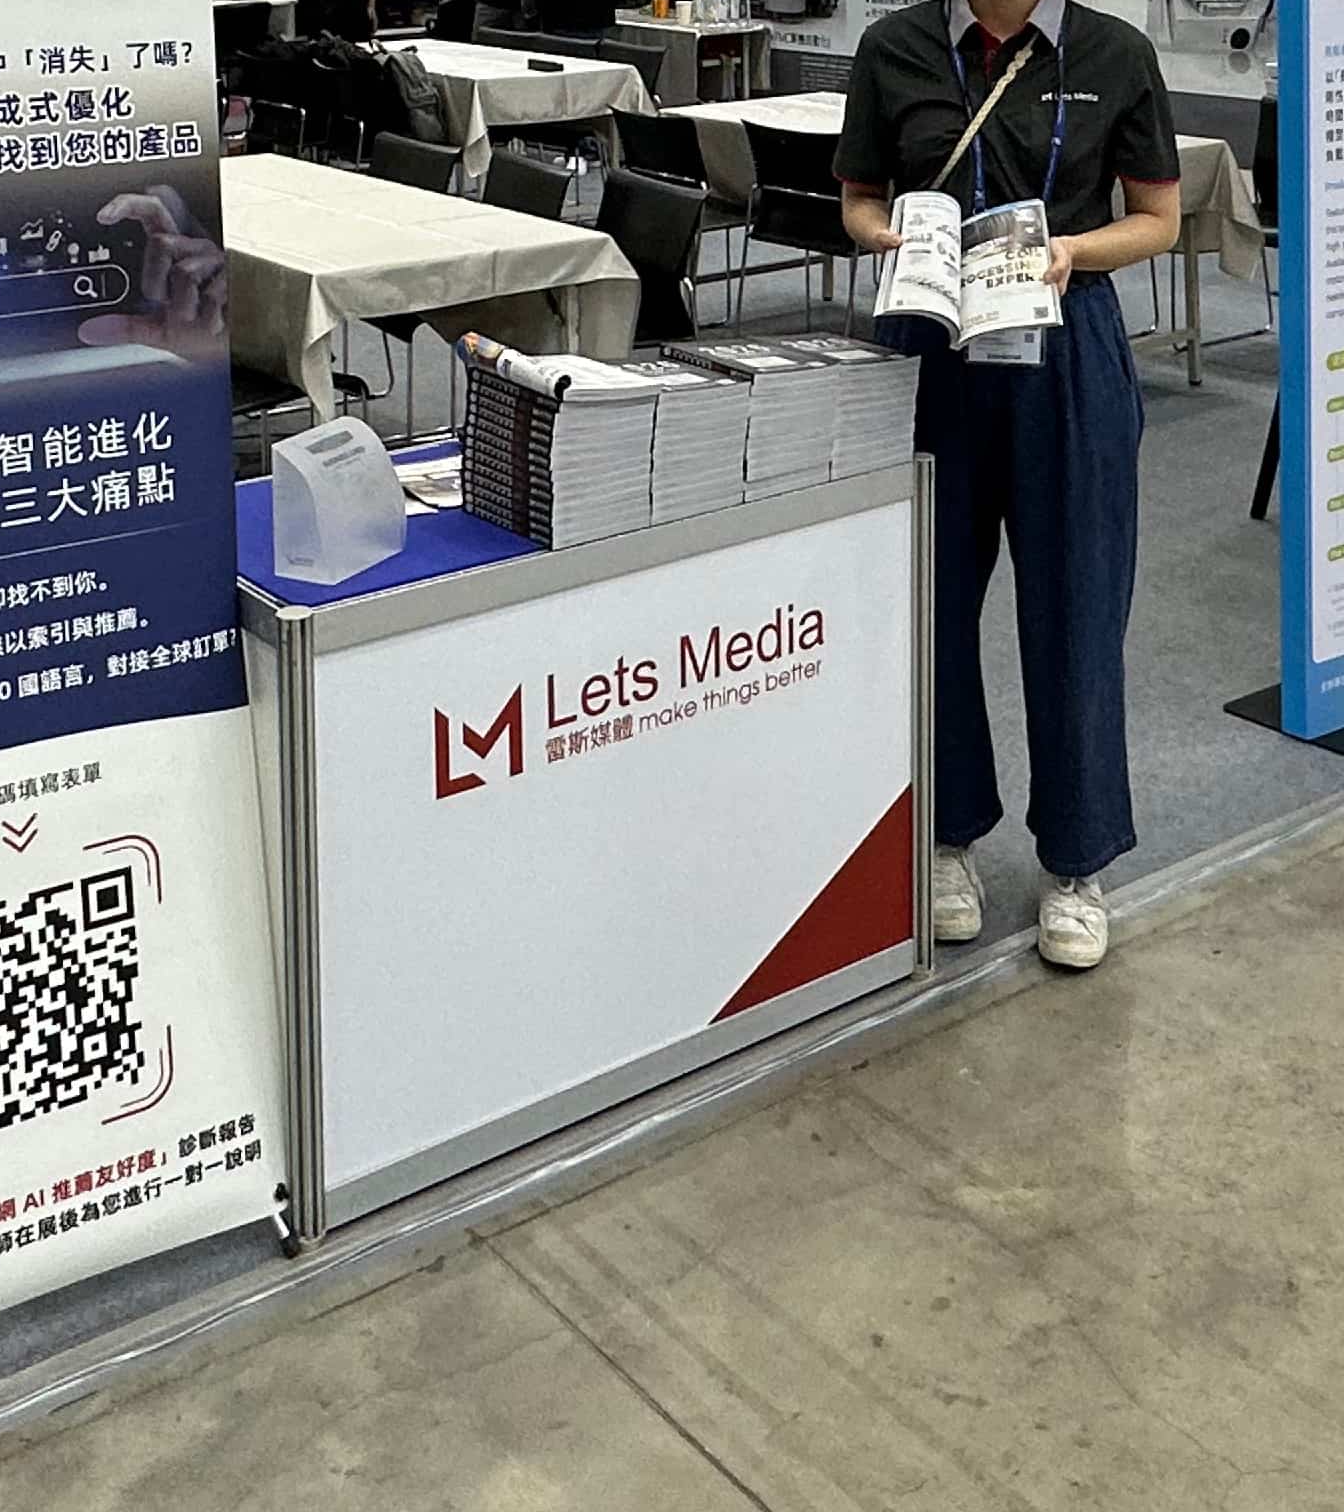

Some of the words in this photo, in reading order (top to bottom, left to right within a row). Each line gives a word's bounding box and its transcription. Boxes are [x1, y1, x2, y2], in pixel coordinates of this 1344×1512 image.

[545, 713, 634, 764] 雷斯媒體
[638, 701, 697, 733] make
[702, 678, 760, 720] things
[765, 658, 822, 692] better
[546, 656, 657, 728] Lets
[678, 604, 825, 691] Media
